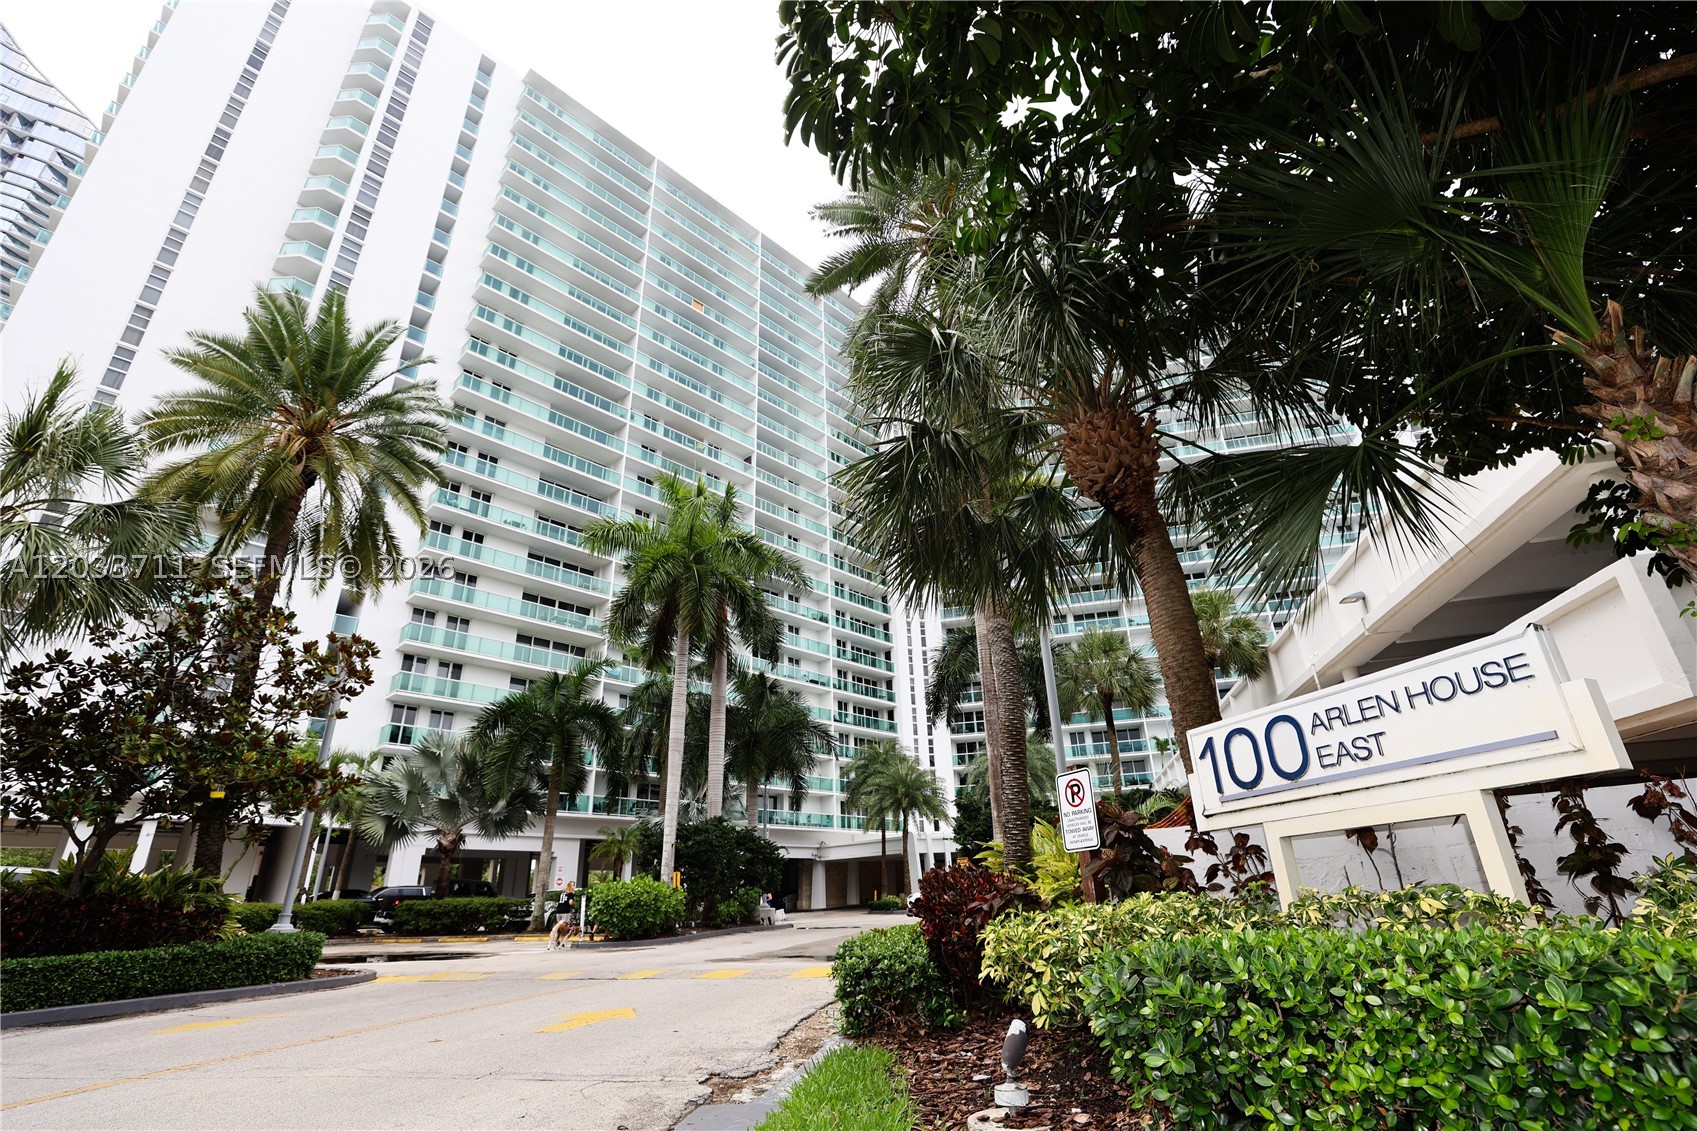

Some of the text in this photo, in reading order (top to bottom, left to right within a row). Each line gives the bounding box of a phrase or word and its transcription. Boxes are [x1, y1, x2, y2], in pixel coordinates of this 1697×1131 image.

[1310, 652, 1535, 736] ARLEN HOUSE
[1199, 714, 1309, 795] 100
[1316, 731, 1386, 769] EAST
[1065, 827, 1081, 835] TOWED
[1071, 808, 1092, 816] PARKING
